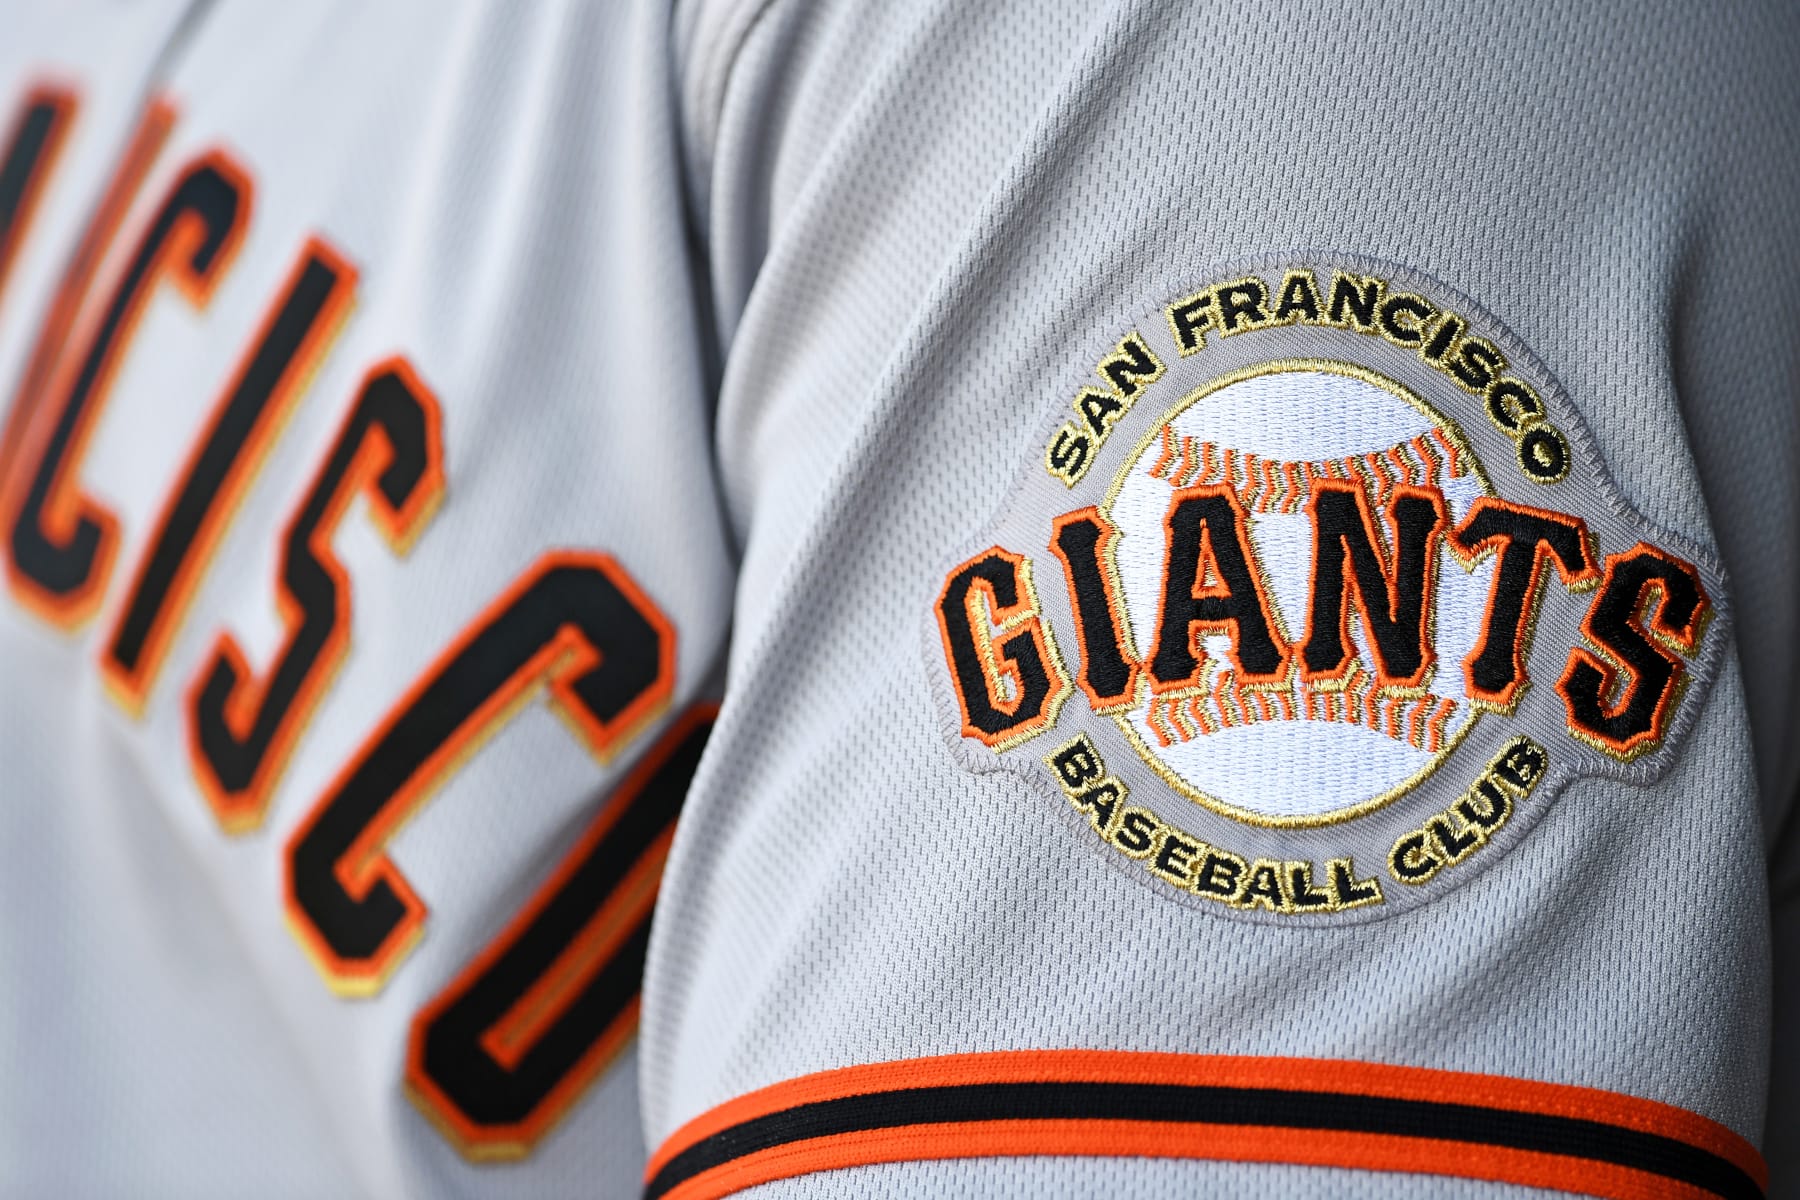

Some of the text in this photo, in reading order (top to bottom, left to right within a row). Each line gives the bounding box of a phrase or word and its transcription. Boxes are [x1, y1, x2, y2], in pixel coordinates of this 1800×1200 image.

[1045, 267, 1571, 488] SAN FRANCISCO
[933, 476, 1713, 763] GIANTS
[1045, 732, 1549, 914] BASEBALL CLUB
